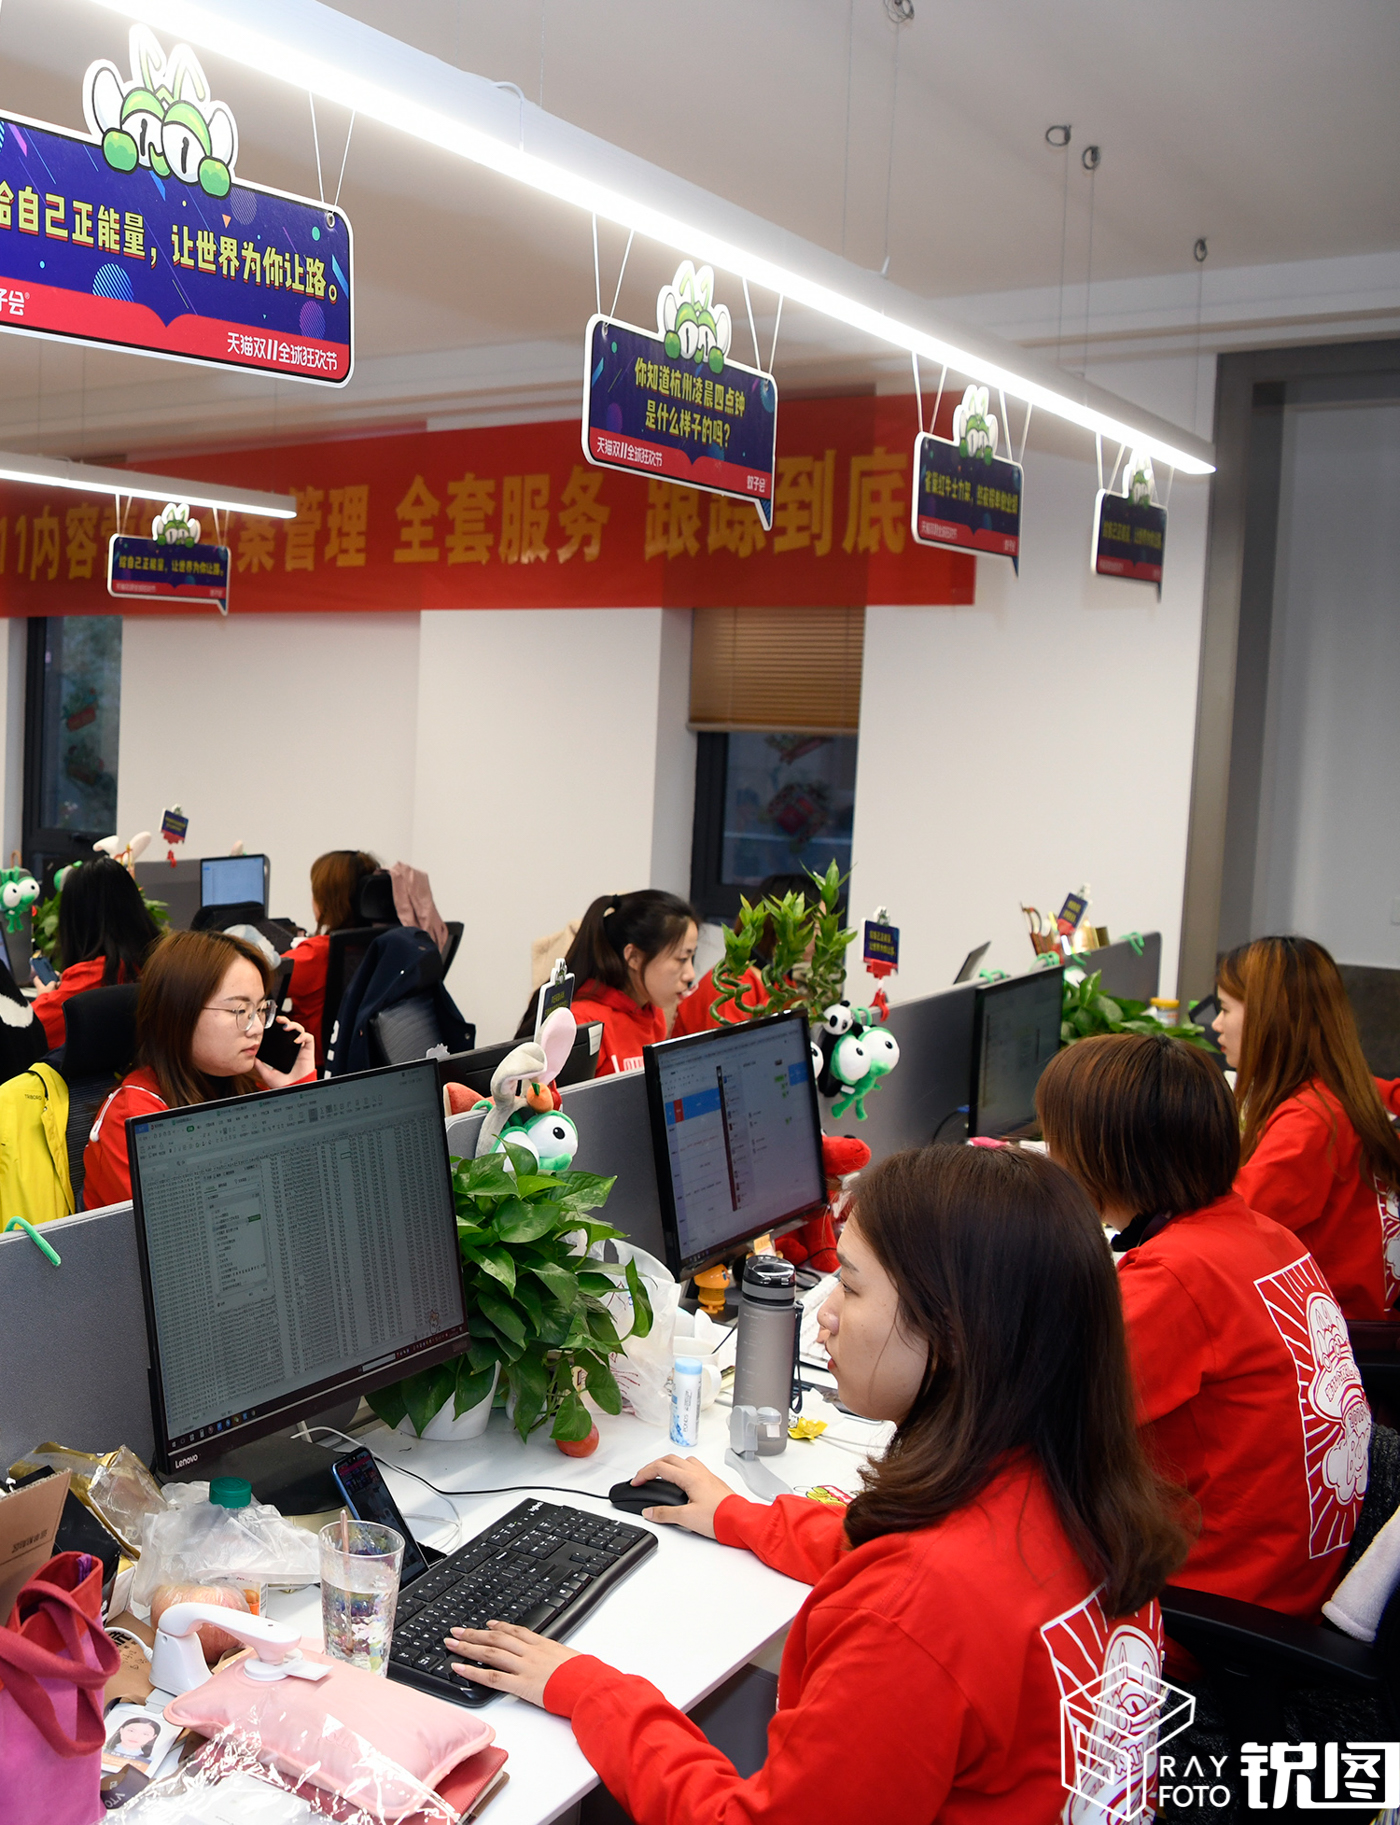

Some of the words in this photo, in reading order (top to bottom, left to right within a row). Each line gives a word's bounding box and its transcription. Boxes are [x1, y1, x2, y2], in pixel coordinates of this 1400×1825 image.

[634, 357, 746, 418] 你知道杭州凌晨四点钟
[645, 399, 731, 448] 是什么样子的吗？
[394, 464, 611, 566] 全套服务
[174, 1453, 199, 1469] Lenovo
